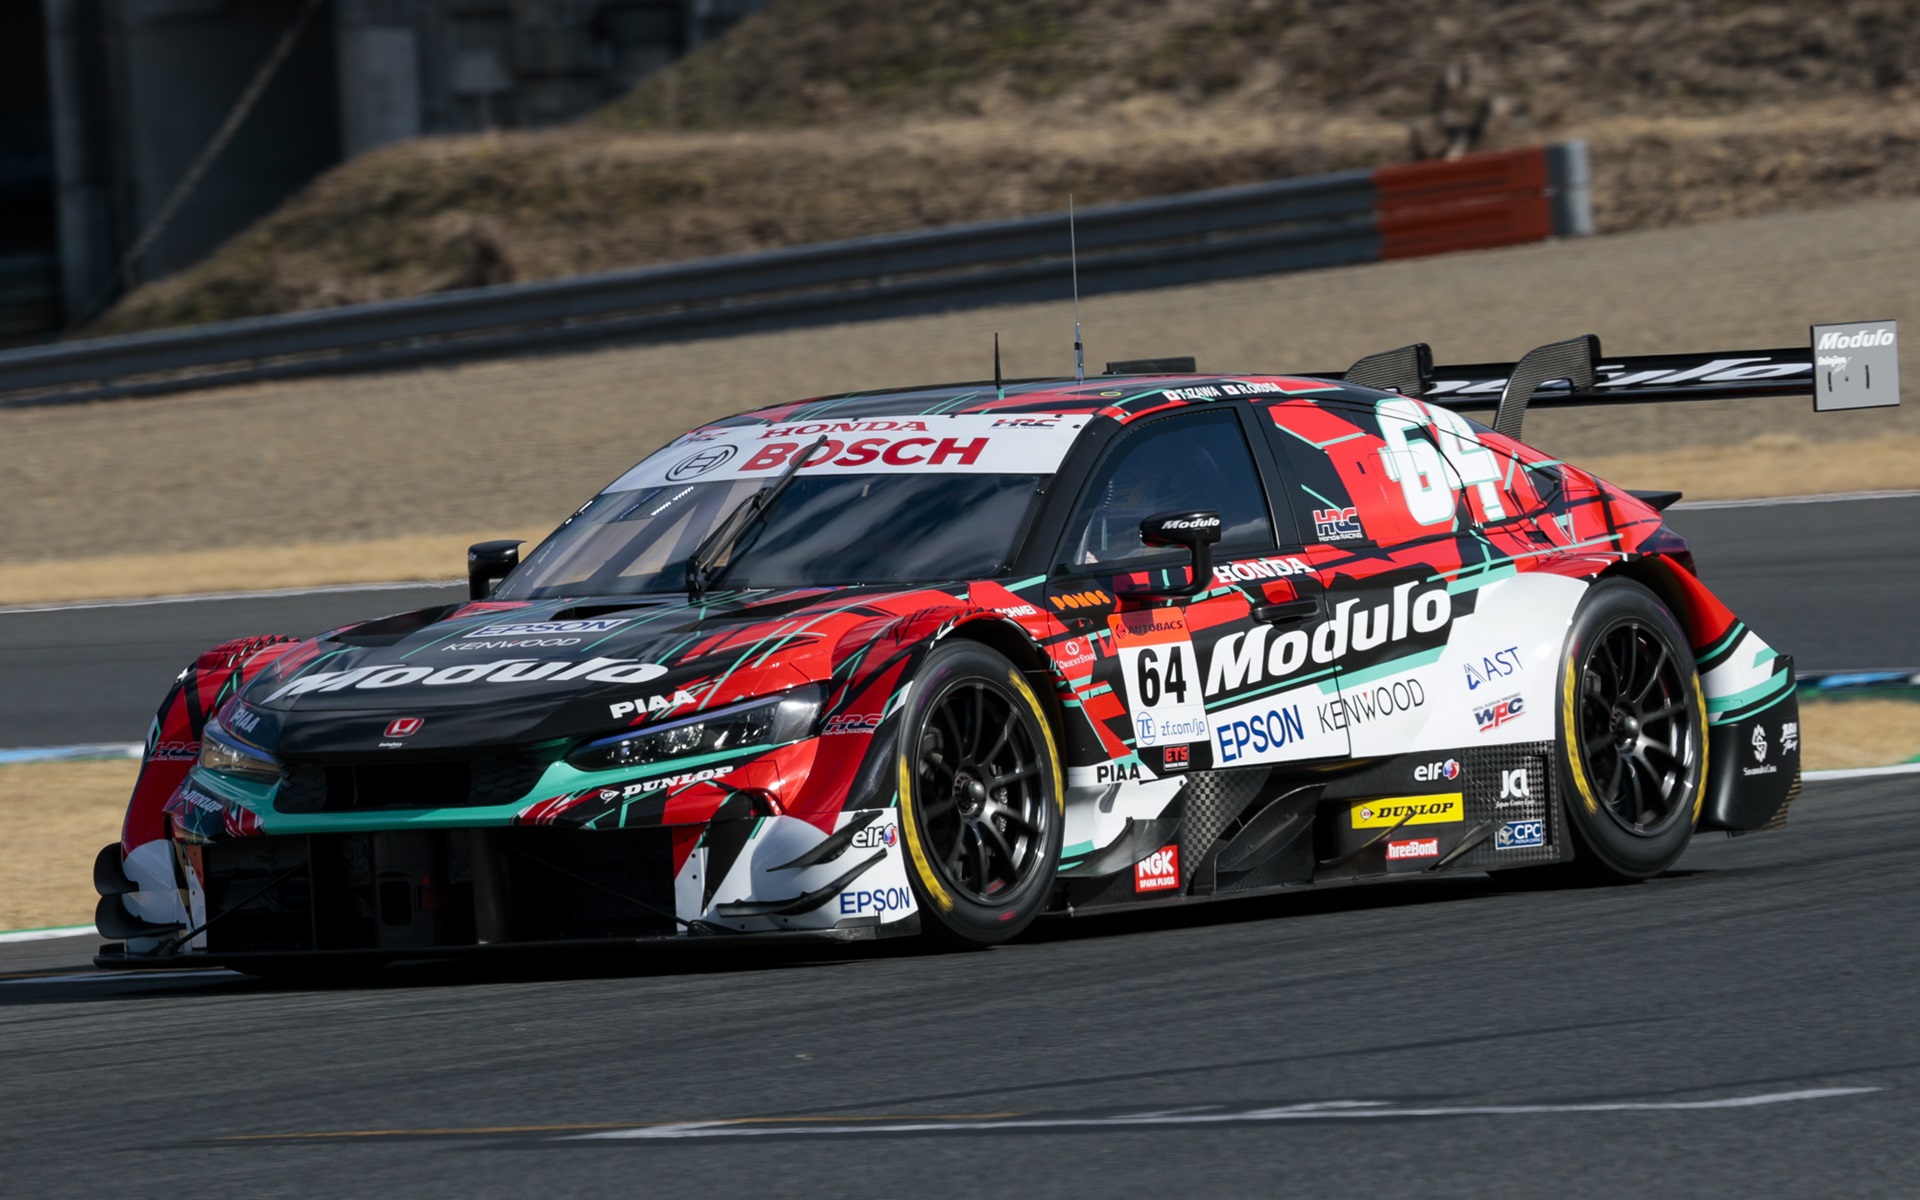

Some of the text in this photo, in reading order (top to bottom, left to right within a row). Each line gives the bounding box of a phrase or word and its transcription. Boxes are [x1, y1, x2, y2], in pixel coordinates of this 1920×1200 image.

[1818, 329, 1895, 350] Modulo
[761, 420, 929, 440] HONDA
[991, 418, 1061, 427] HRC
[738, 437, 990, 472] BOSCH
[1375, 398, 1506, 526] 64
[1161, 517, 1220, 530] Modulo
[1313, 507, 1361, 536] HRC
[1213, 557, 1316, 583] HONDA
[1050, 590, 1111, 610] PONOS
[475, 620, 623, 637] EPSON
[1128, 620, 1183, 635] AUTOBACS
[441, 638, 582, 651] KENWOOD
[1204, 581, 1451, 697] Modulo
[1483, 646, 1523, 682] AST
[260, 657, 669, 705] Modulo
[1136, 646, 1188, 708] 64
[609, 690, 697, 719] PIAA
[1317, 679, 1425, 734] KENWOOD
[229, 709, 260, 733] PIAA
[822, 713, 885, 731] HRC
[1161, 718, 1205, 738] zf.com/jp
[1216, 705, 1305, 763] EPSON
[1165, 746, 1188, 762] ETS
[622, 766, 734, 797] DUNLOP
[1096, 762, 1141, 783] PIAA
[1414, 761, 1442, 781] elf
[184, 790, 223, 813] DUNLOP
[1376, 802, 1454, 819] DUNLOP
[852, 826, 884, 848] elf
[1514, 824, 1541, 839] CPC
[1138, 850, 1174, 878] NGK
[840, 886, 910, 915] EPSON
